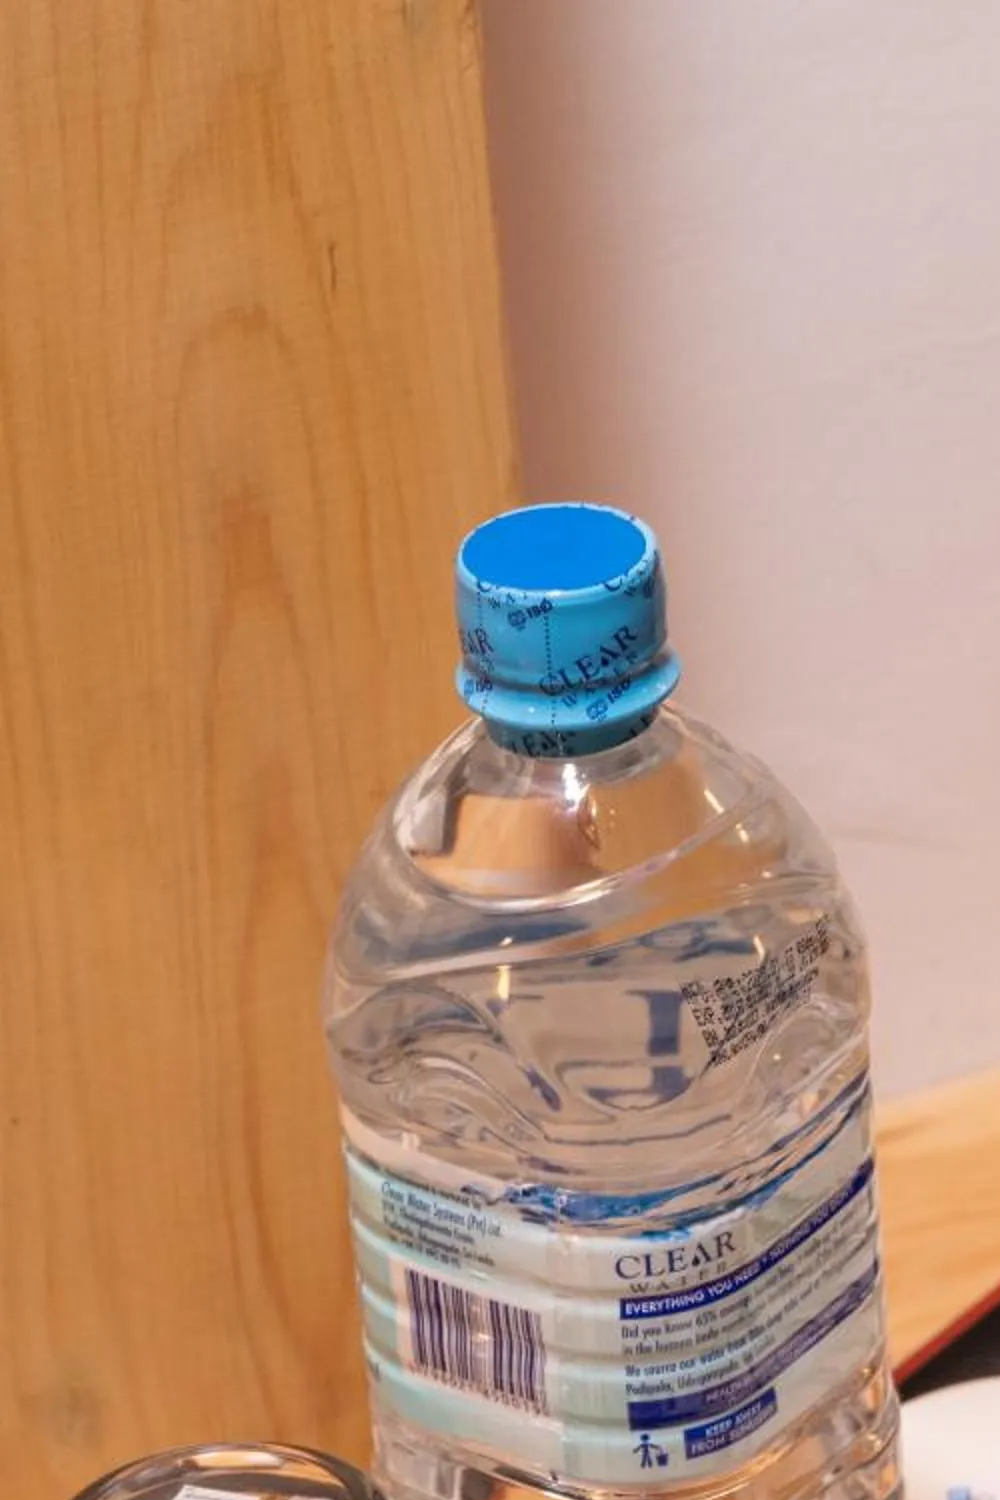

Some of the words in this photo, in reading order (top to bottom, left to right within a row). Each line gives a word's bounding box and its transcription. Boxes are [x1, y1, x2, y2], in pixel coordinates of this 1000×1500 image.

[539, 625, 638, 697] CLEAR
[615, 1230, 737, 1280] CLEAR
[624, 1289, 706, 1317] EVERYTHING
[707, 1278, 735, 1298] YOU
